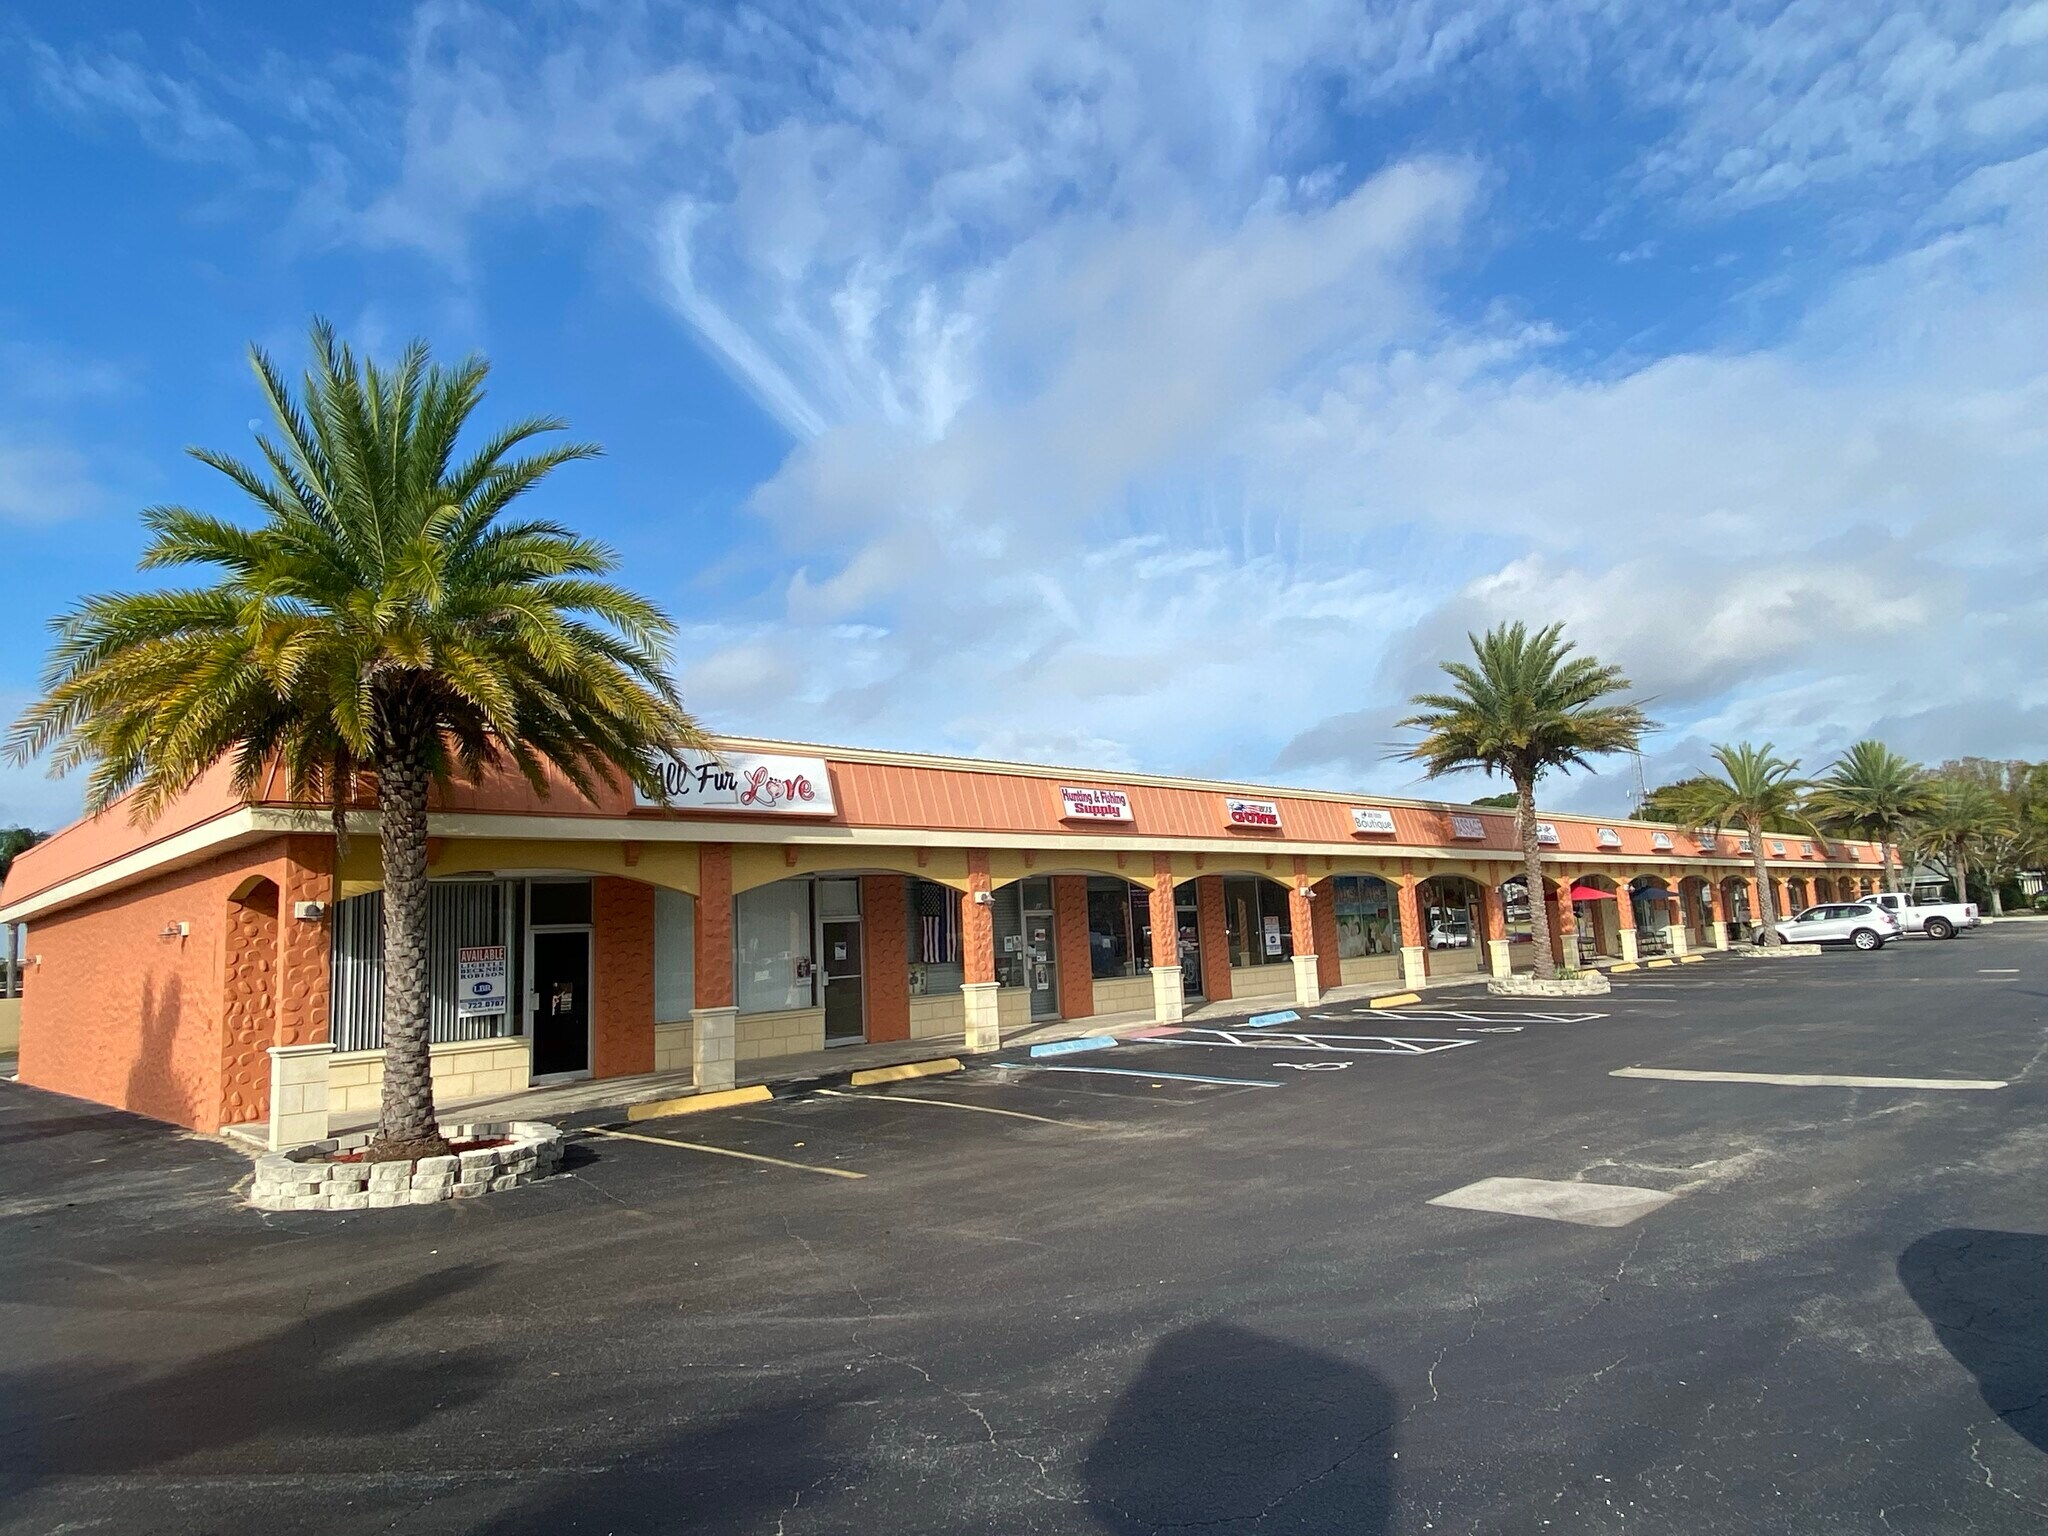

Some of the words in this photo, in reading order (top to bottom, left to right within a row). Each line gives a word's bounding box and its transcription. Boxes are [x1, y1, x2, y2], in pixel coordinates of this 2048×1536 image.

[695, 762, 738, 793] Fur
[740, 766, 815, 807] Love
[1061, 788, 1093, 804] Hunting
[1093, 790, 1100, 803] &
[1100, 791, 1126, 806] Fishing
[1074, 803, 1121, 817] Supply
[1355, 817, 1392, 830] Boutique
[461, 949, 504, 962] AVAILABLE
